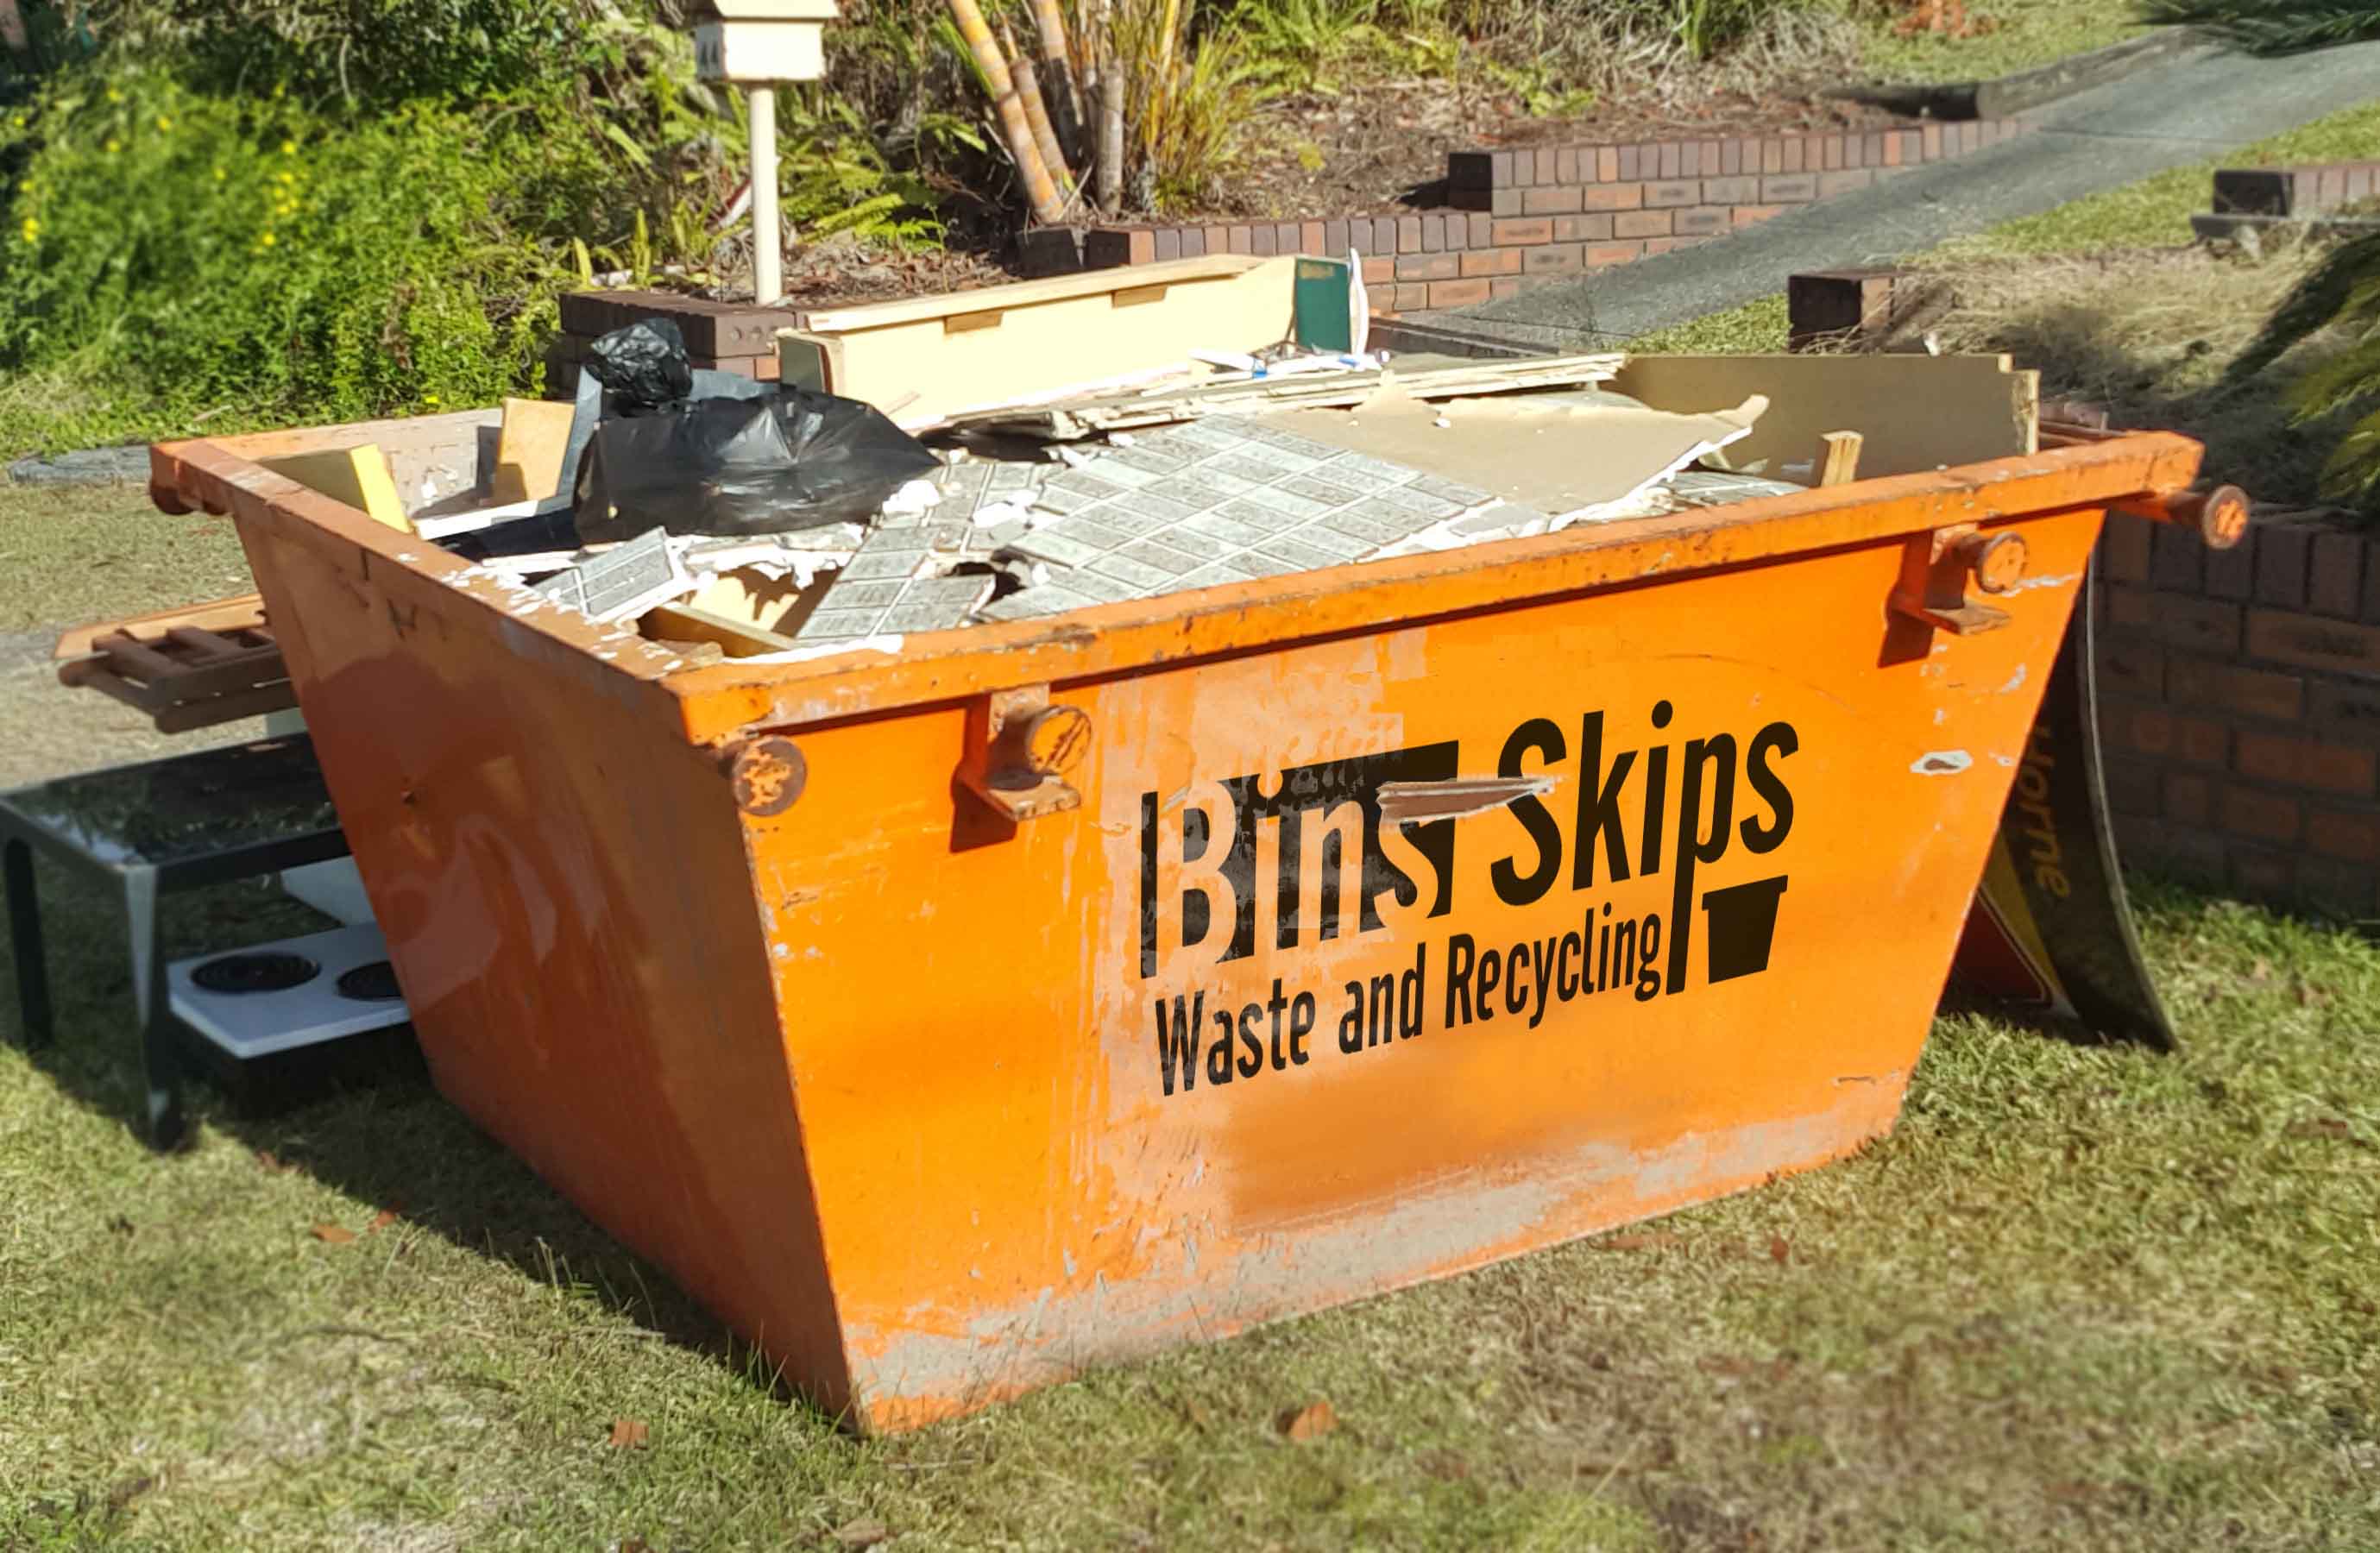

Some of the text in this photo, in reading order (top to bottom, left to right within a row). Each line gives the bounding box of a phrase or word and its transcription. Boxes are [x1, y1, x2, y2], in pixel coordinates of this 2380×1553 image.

[1141, 700, 1799, 995] Bins Skips
[1155, 902, 1661, 1097] Waste and Recycling
